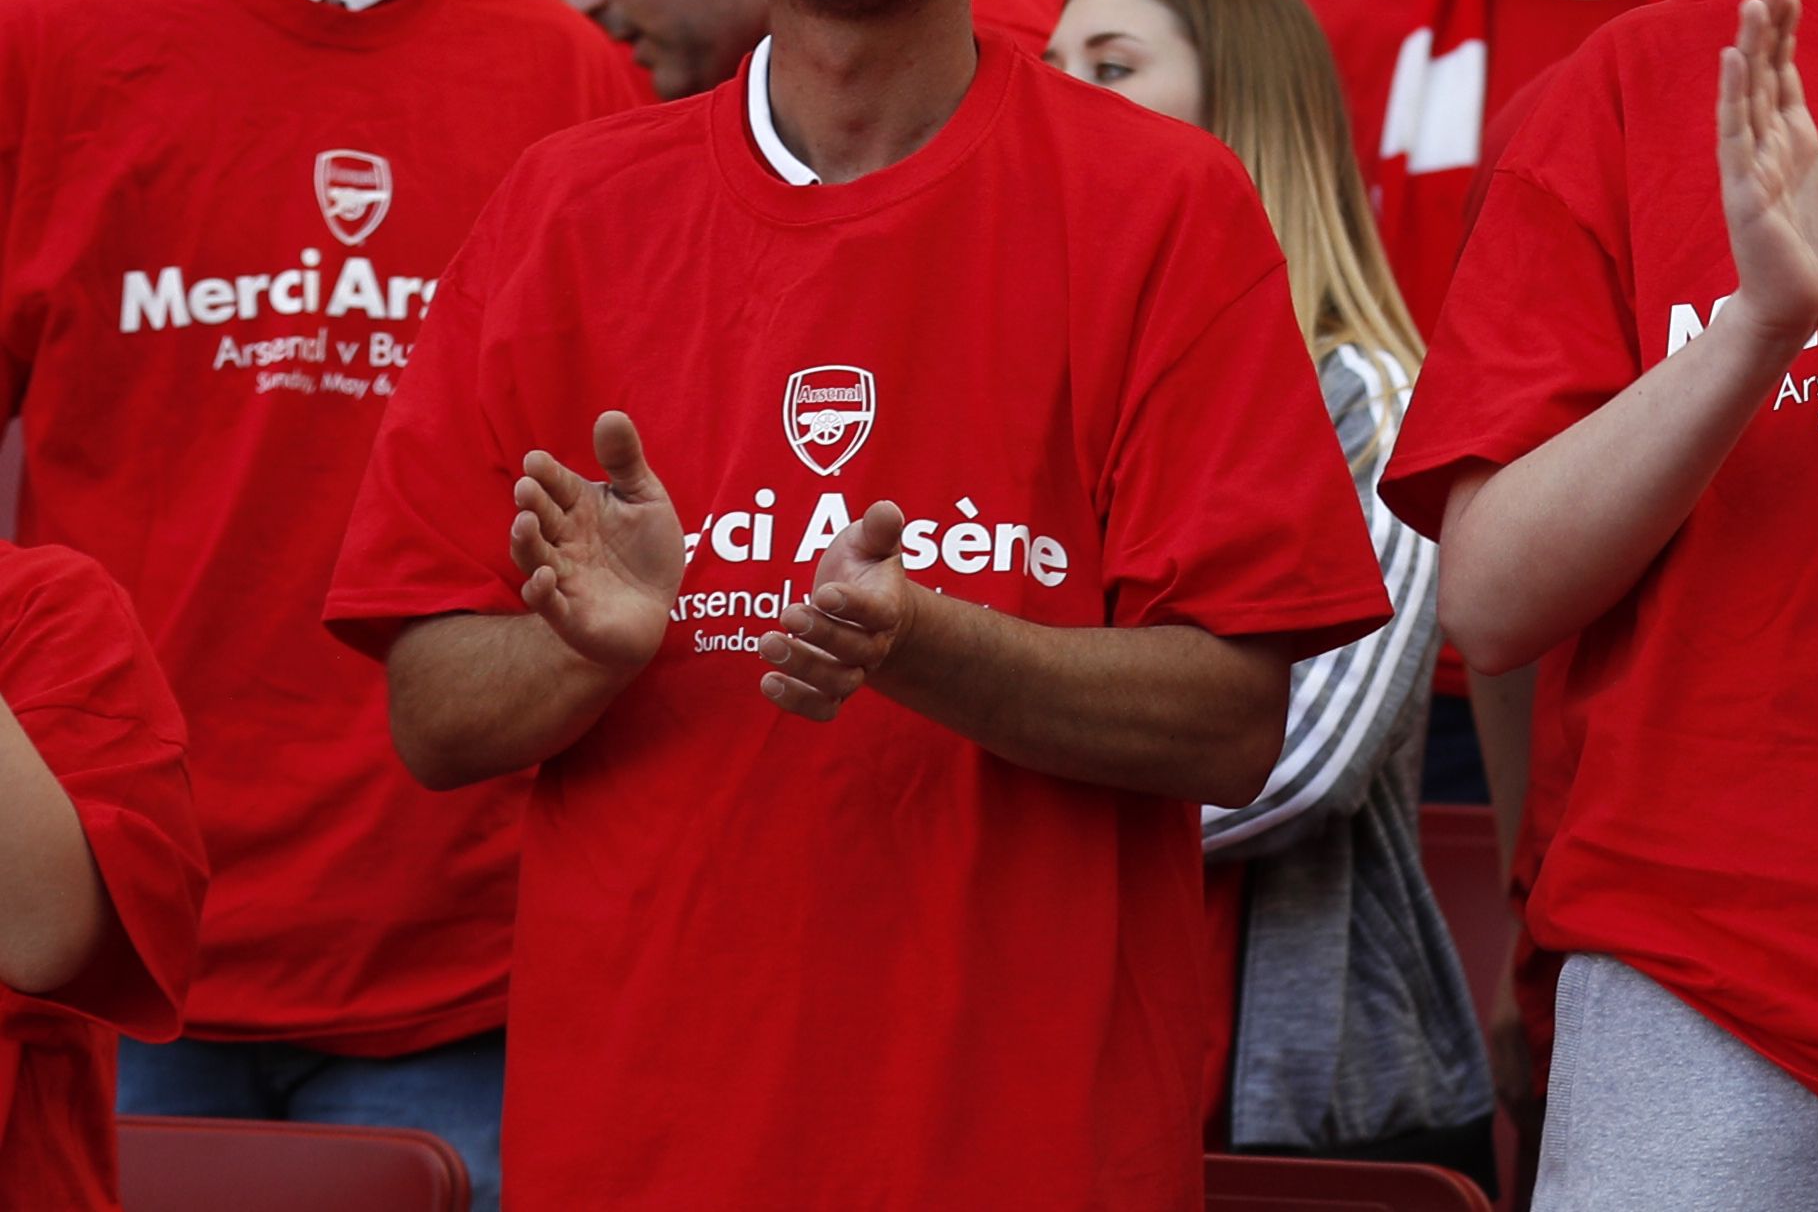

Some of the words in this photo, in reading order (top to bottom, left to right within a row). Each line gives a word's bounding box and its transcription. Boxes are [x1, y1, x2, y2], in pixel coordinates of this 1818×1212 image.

[118, 248, 320, 332] Merci
[335, 340, 360, 365] v
[797, 383, 864, 403] Arsenal
[793, 493, 1068, 587] Asène
[669, 579, 792, 622] rsenal
[693, 626, 762, 659] Sunda
